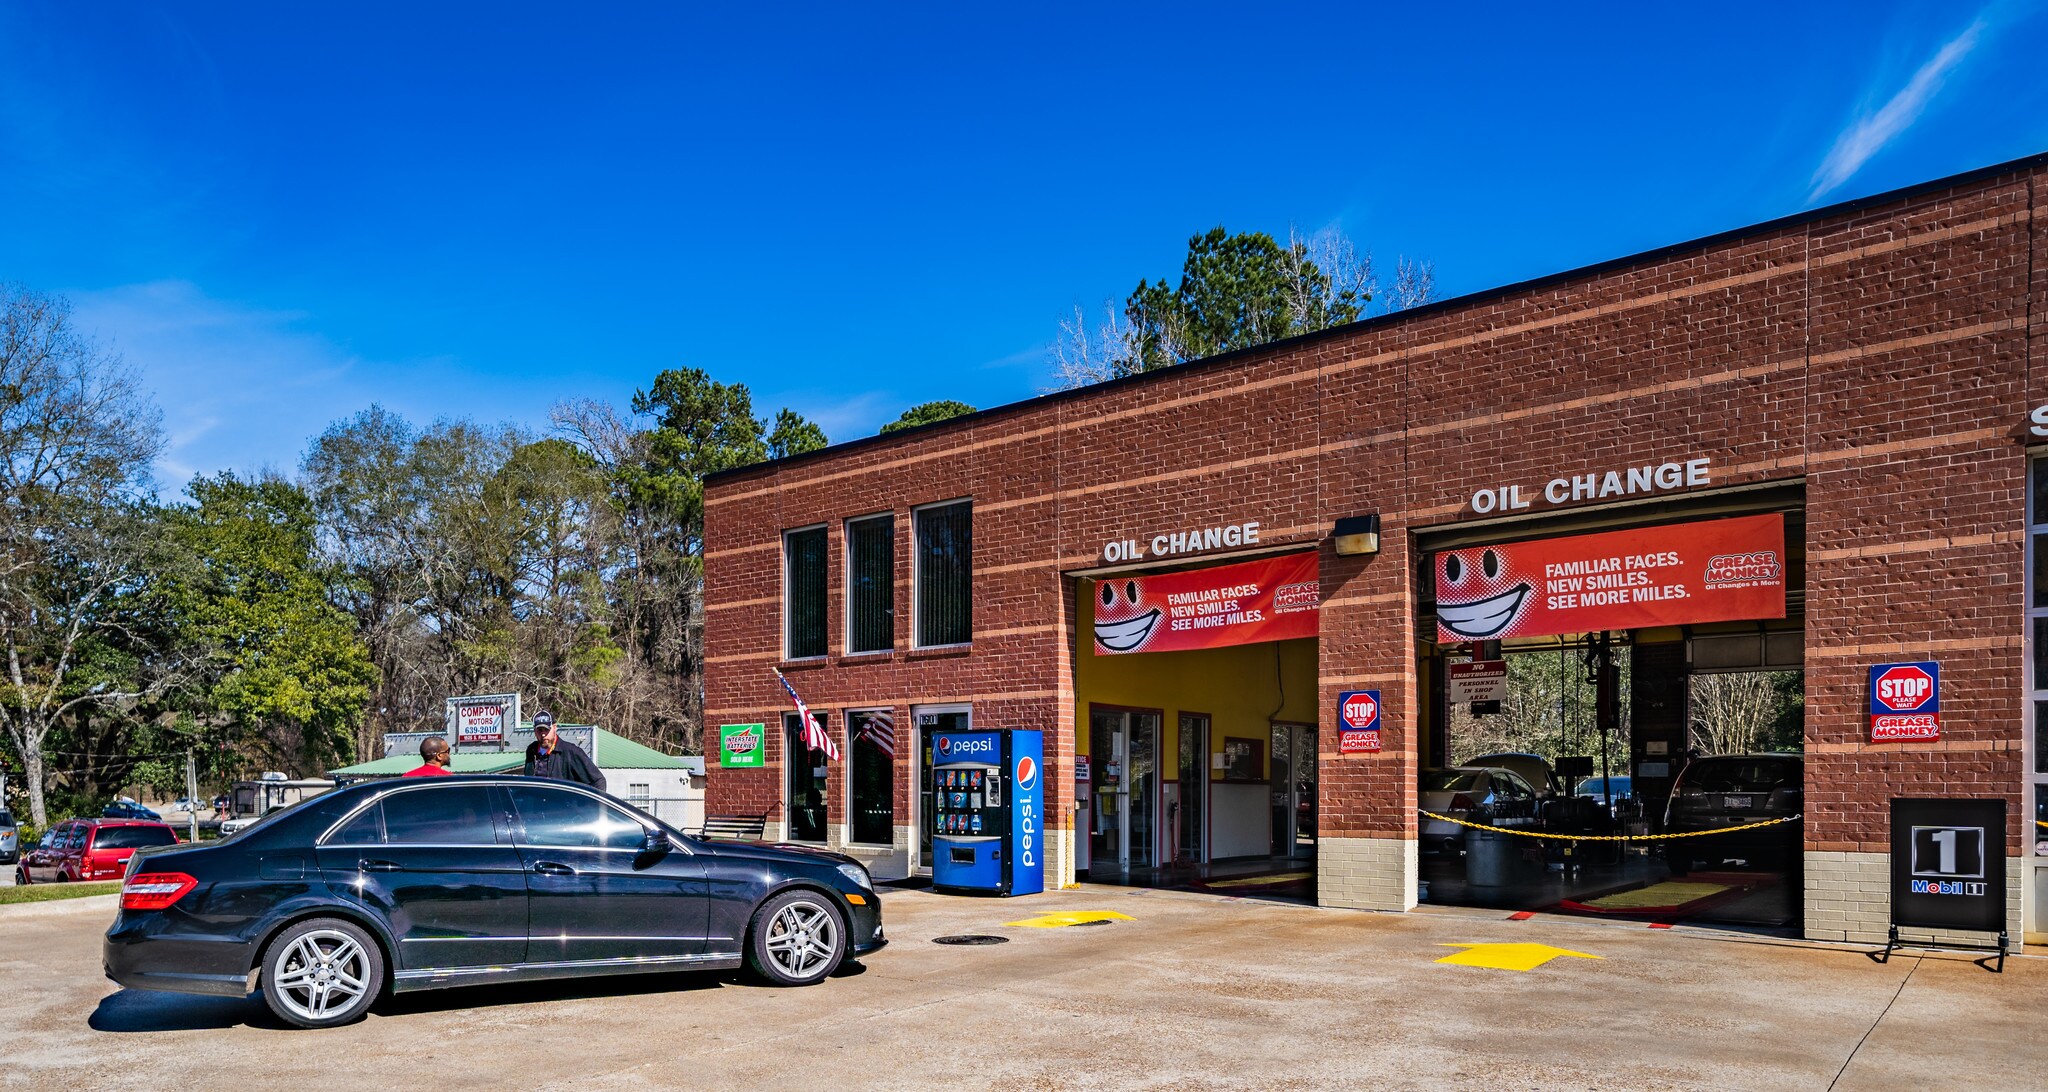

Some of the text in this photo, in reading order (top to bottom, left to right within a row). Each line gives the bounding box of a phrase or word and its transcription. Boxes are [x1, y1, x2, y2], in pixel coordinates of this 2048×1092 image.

[1471, 457, 1710, 514] OIL CHANGE
[1104, 521, 1260, 562] OIL CHANGE
[1545, 551, 1684, 578] FAMILIAR FACES.
[1711, 553, 1774, 570] GREASE
[1707, 565, 1778, 580] MONKEY
[1278, 583, 1320, 597] GREASE
[1547, 571, 1653, 594] NEW SMILES.
[1717, 581, 1750, 589] Changes
[1167, 583, 1261, 606] FAMILIAR FACES.
[1547, 584, 1691, 610] SEE MORE MILES.
[1170, 599, 1241, 618] NEW SMILES.
[1171, 609, 1266, 631] SEE MORE MILES.
[1880, 678, 1929, 698] STOP
[461, 706, 501, 717] COMPTON
[1345, 702, 1375, 718] STOP
[468, 717, 493, 725] MOTORS
[1878, 717, 1931, 727] GREASE
[464, 726, 497, 734] 639-2010
[1345, 733, 1376, 741] GREASE
[1874, 726, 1935, 737] MONKEY
[953, 738, 992, 754] pepsi
[1342, 740, 1378, 748] MONKEY
[1020, 795, 1036, 867] pepsi
[1932, 830, 1956, 874] 1
[1911, 880, 1963, 895] Mobil
